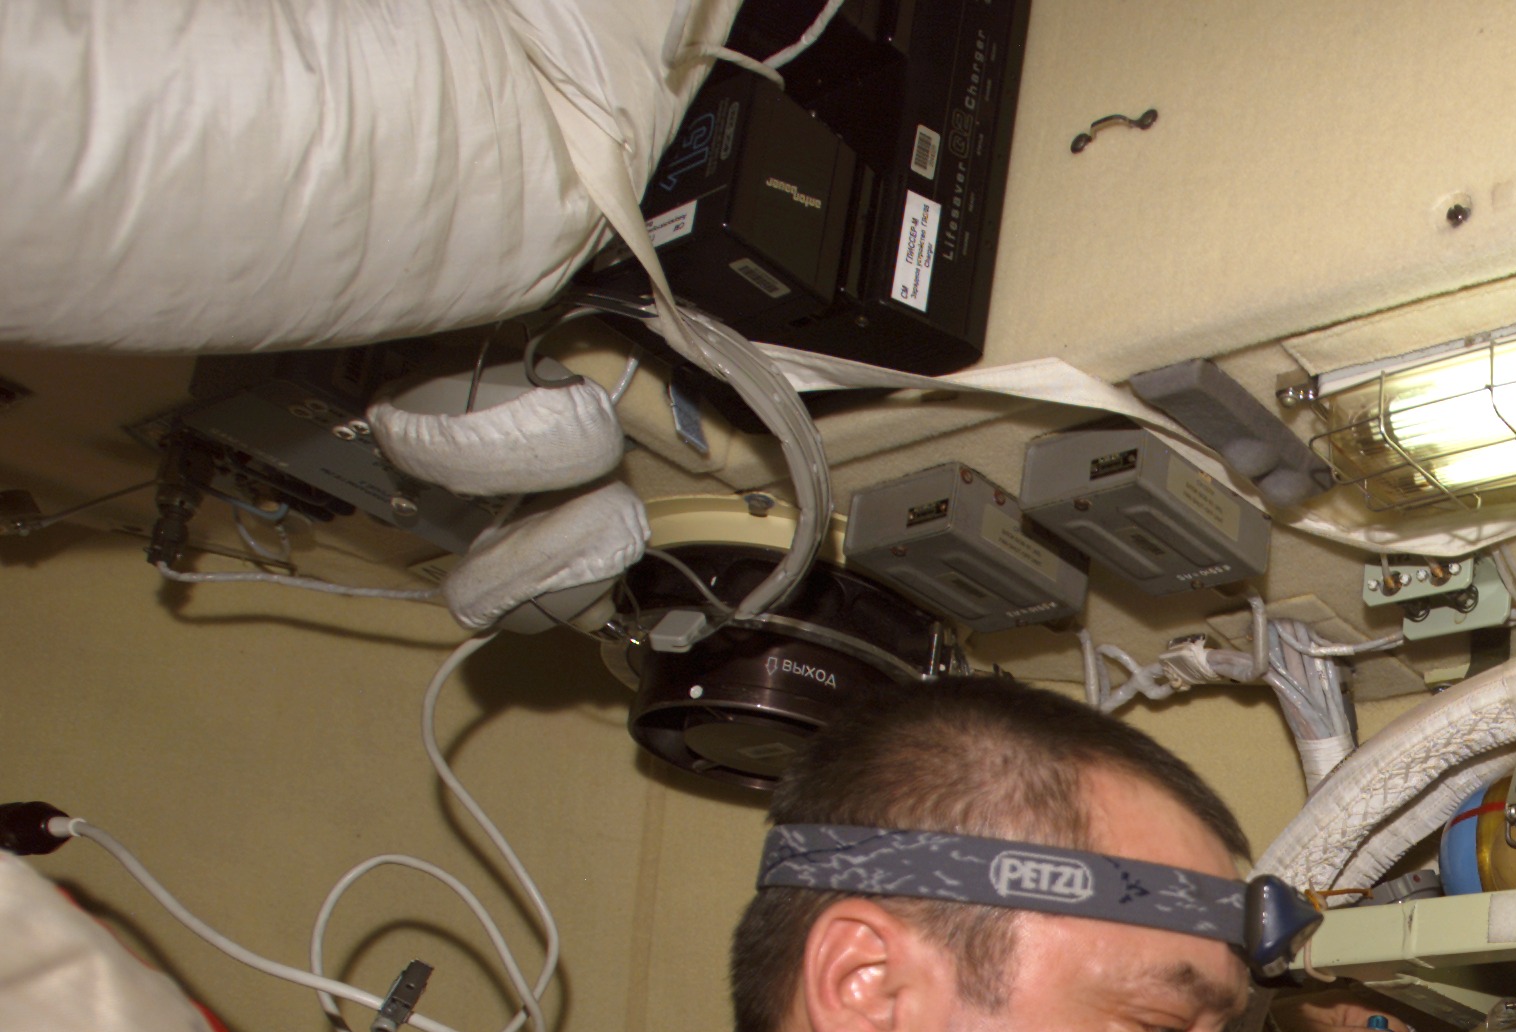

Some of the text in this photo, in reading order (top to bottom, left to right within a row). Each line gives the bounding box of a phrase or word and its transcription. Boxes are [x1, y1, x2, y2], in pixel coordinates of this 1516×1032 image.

[942, 160, 967, 262] Lifesaver
[964, 28, 987, 111] Charger
[782, 658, 837, 689] ВЫХОД
[997, 856, 1094, 898] PETZL
